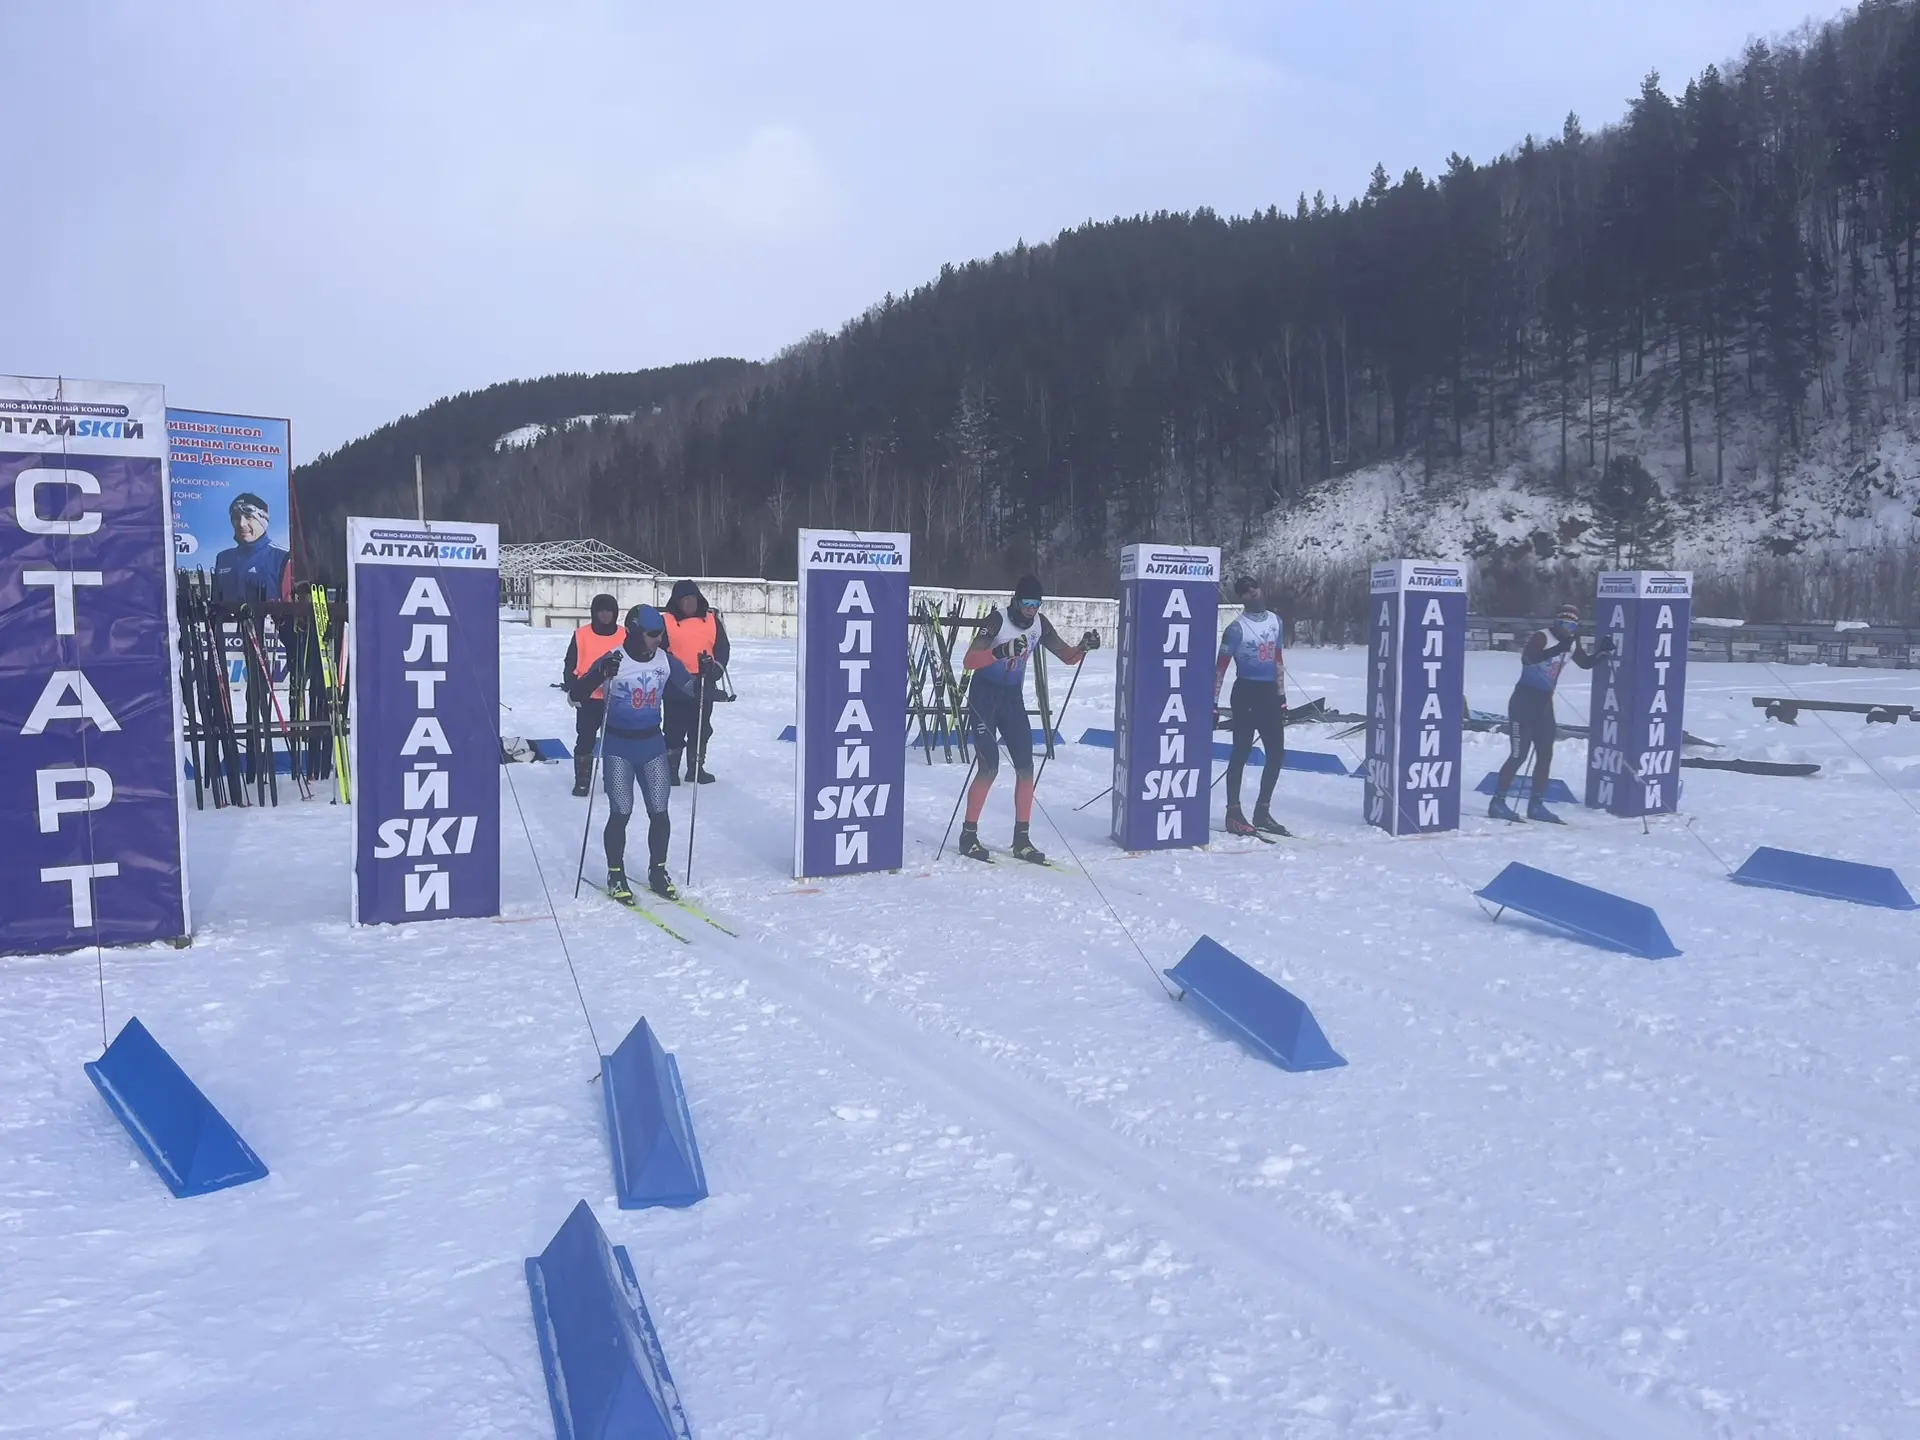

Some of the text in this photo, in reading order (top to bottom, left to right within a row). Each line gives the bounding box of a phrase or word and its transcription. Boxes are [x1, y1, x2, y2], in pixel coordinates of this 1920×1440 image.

[81, 405, 126, 415] КОМПЛЕКС
[221, 426, 262, 438] школ
[227, 442, 281, 454] гонкам
[201, 452, 274, 469] Денисова
[361, 542, 487, 560] АЛТАЙSKIЙ
[809, 550, 903, 566] АЛТАЙSKIЙ
[14, 467, 123, 928] СТАРТ
[631, 687, 657, 710] 84
